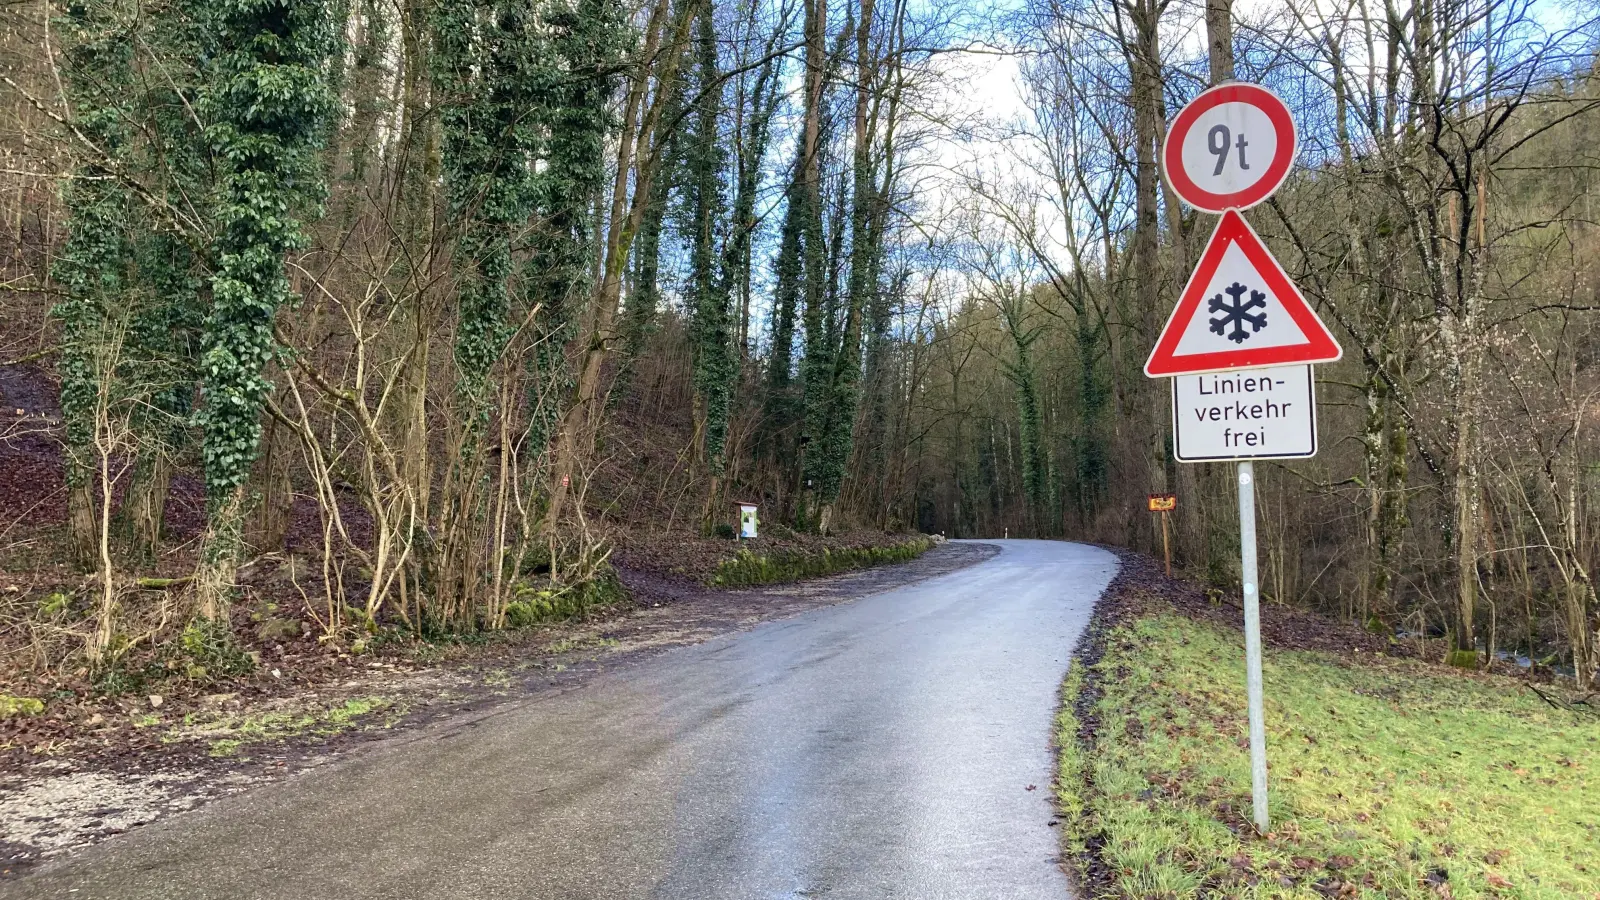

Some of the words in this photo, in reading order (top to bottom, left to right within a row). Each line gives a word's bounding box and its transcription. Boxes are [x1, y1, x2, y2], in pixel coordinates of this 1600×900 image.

[1199, 374, 1285, 396] Linien-
[1194, 399, 1292, 422] verkehr
[1223, 426, 1265, 448] frei
